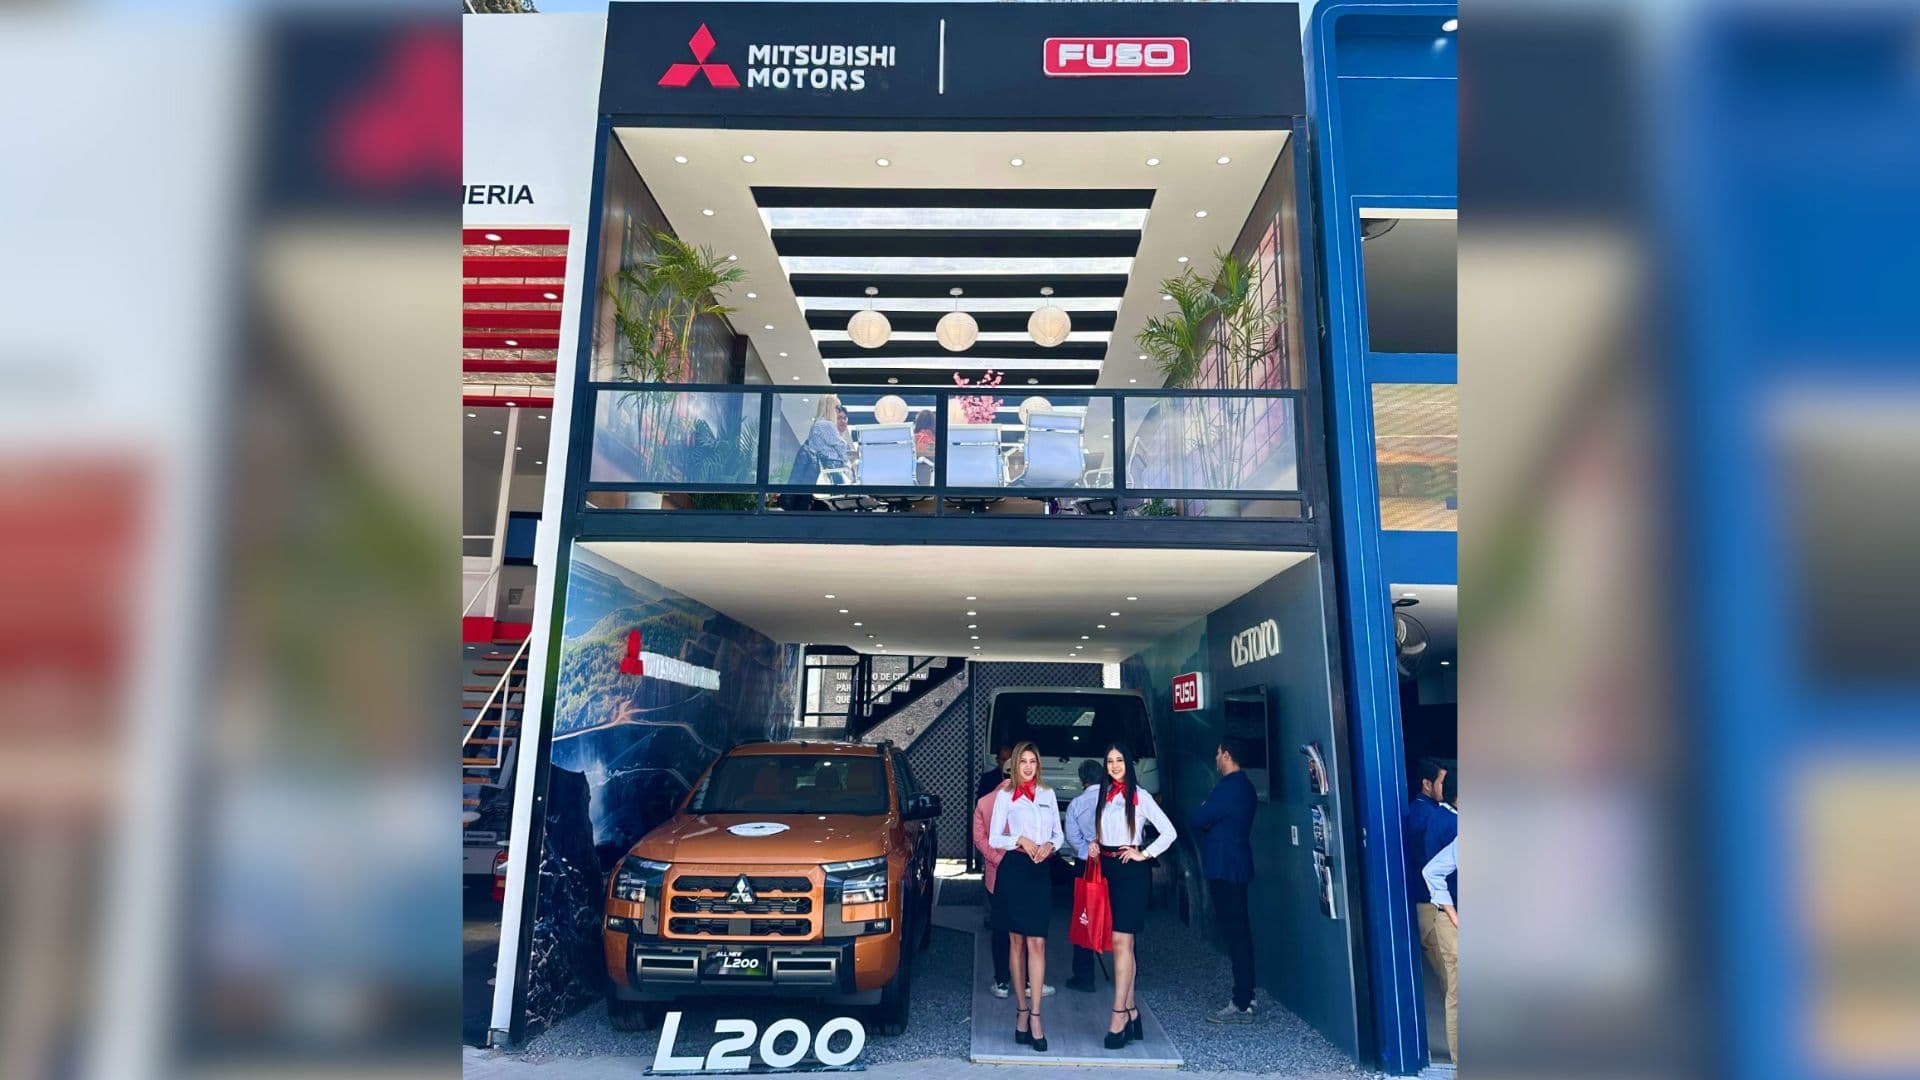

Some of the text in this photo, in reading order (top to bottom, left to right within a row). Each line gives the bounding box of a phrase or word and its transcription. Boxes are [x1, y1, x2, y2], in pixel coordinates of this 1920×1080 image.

[748, 44, 896, 67] MITSUBISHI
[1058, 43, 1175, 68] FUSO
[747, 67, 865, 91] MOTORS
[463, 185, 534, 204] ERIA
[1175, 681, 1196, 703] FUSO
[723, 957, 759, 968] L200
[652, 1011, 866, 1071] L200
